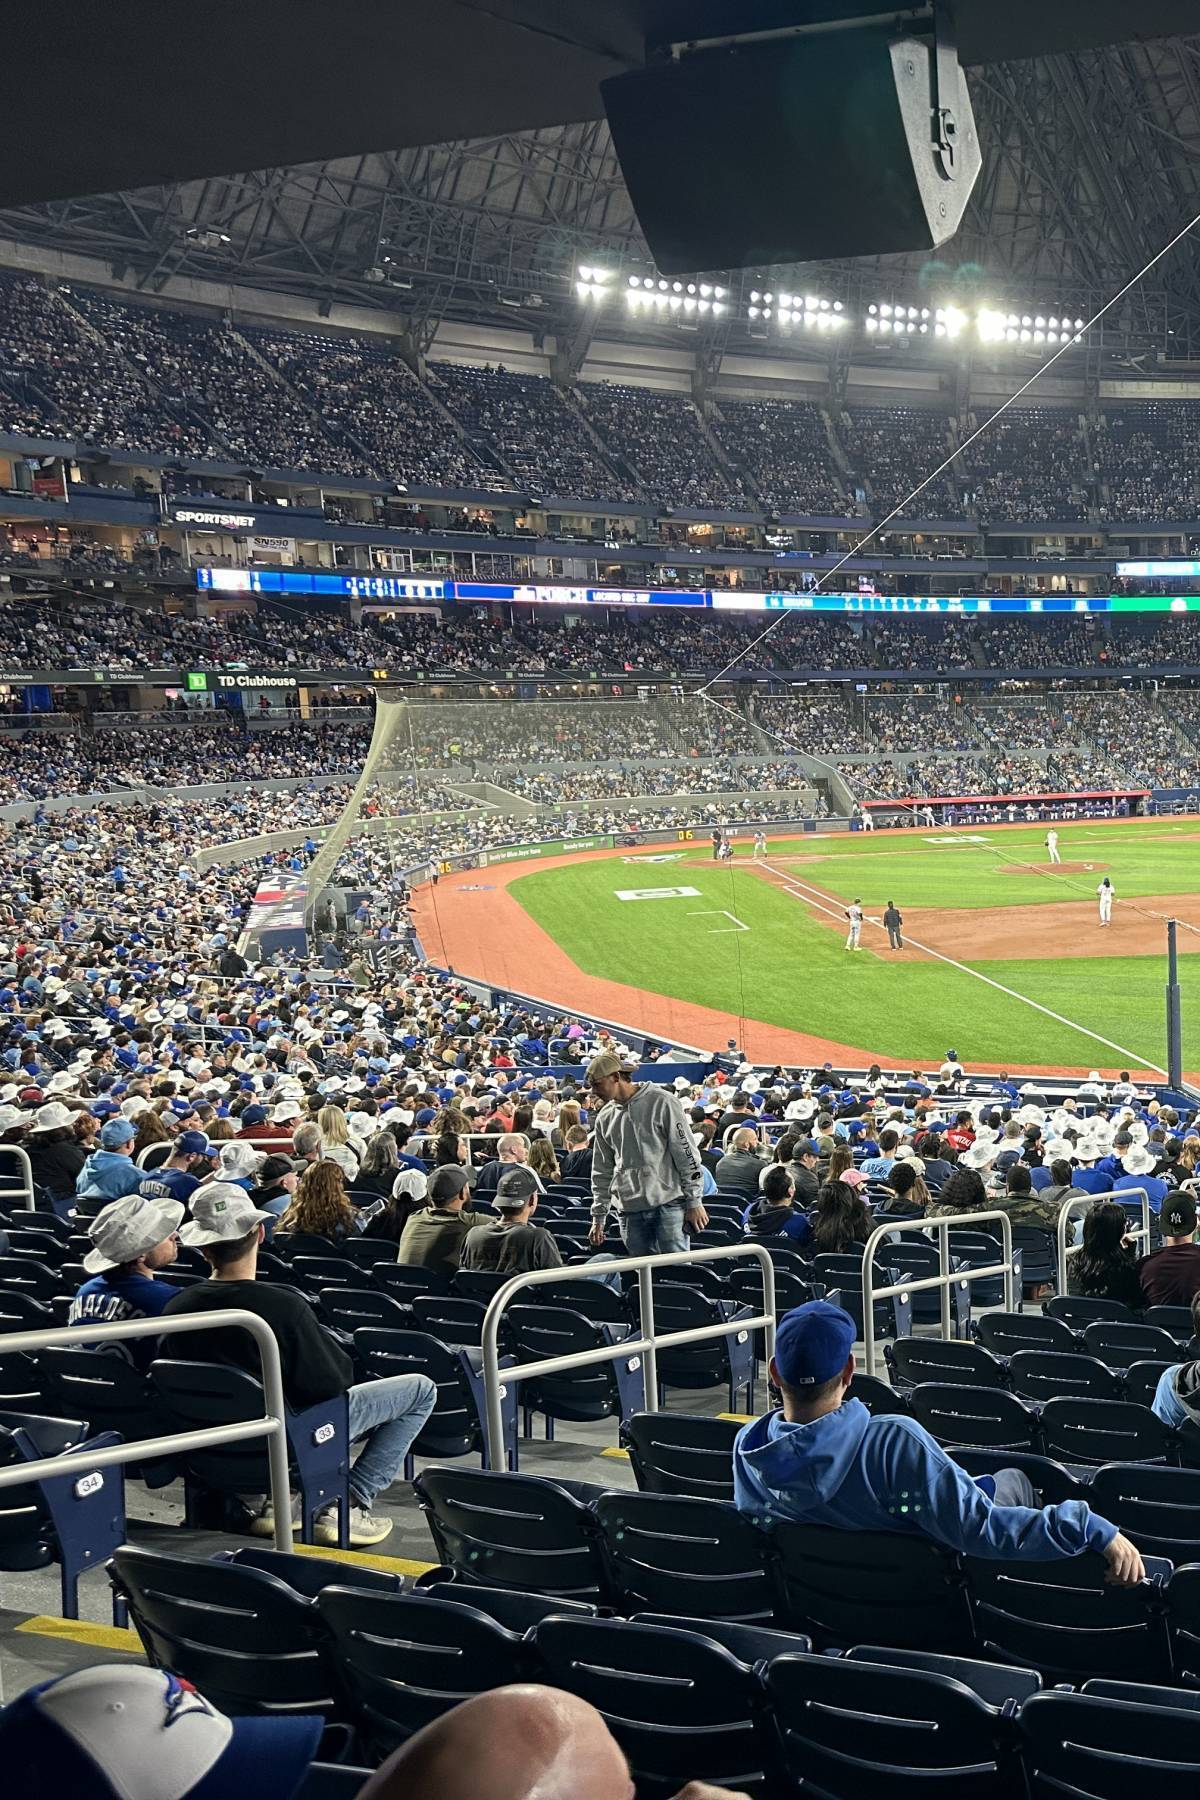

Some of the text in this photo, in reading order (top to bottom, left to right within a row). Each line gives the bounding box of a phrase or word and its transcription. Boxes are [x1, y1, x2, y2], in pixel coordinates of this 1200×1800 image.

[175, 510, 255, 527] SPORTSNET
[218, 676, 236, 687] TD
[237, 675, 297, 687] Clubhouse
[676, 1122, 698, 1170] carhartt
[318, 1426, 331, 1440] 33
[82, 1477, 98, 1493] 34
